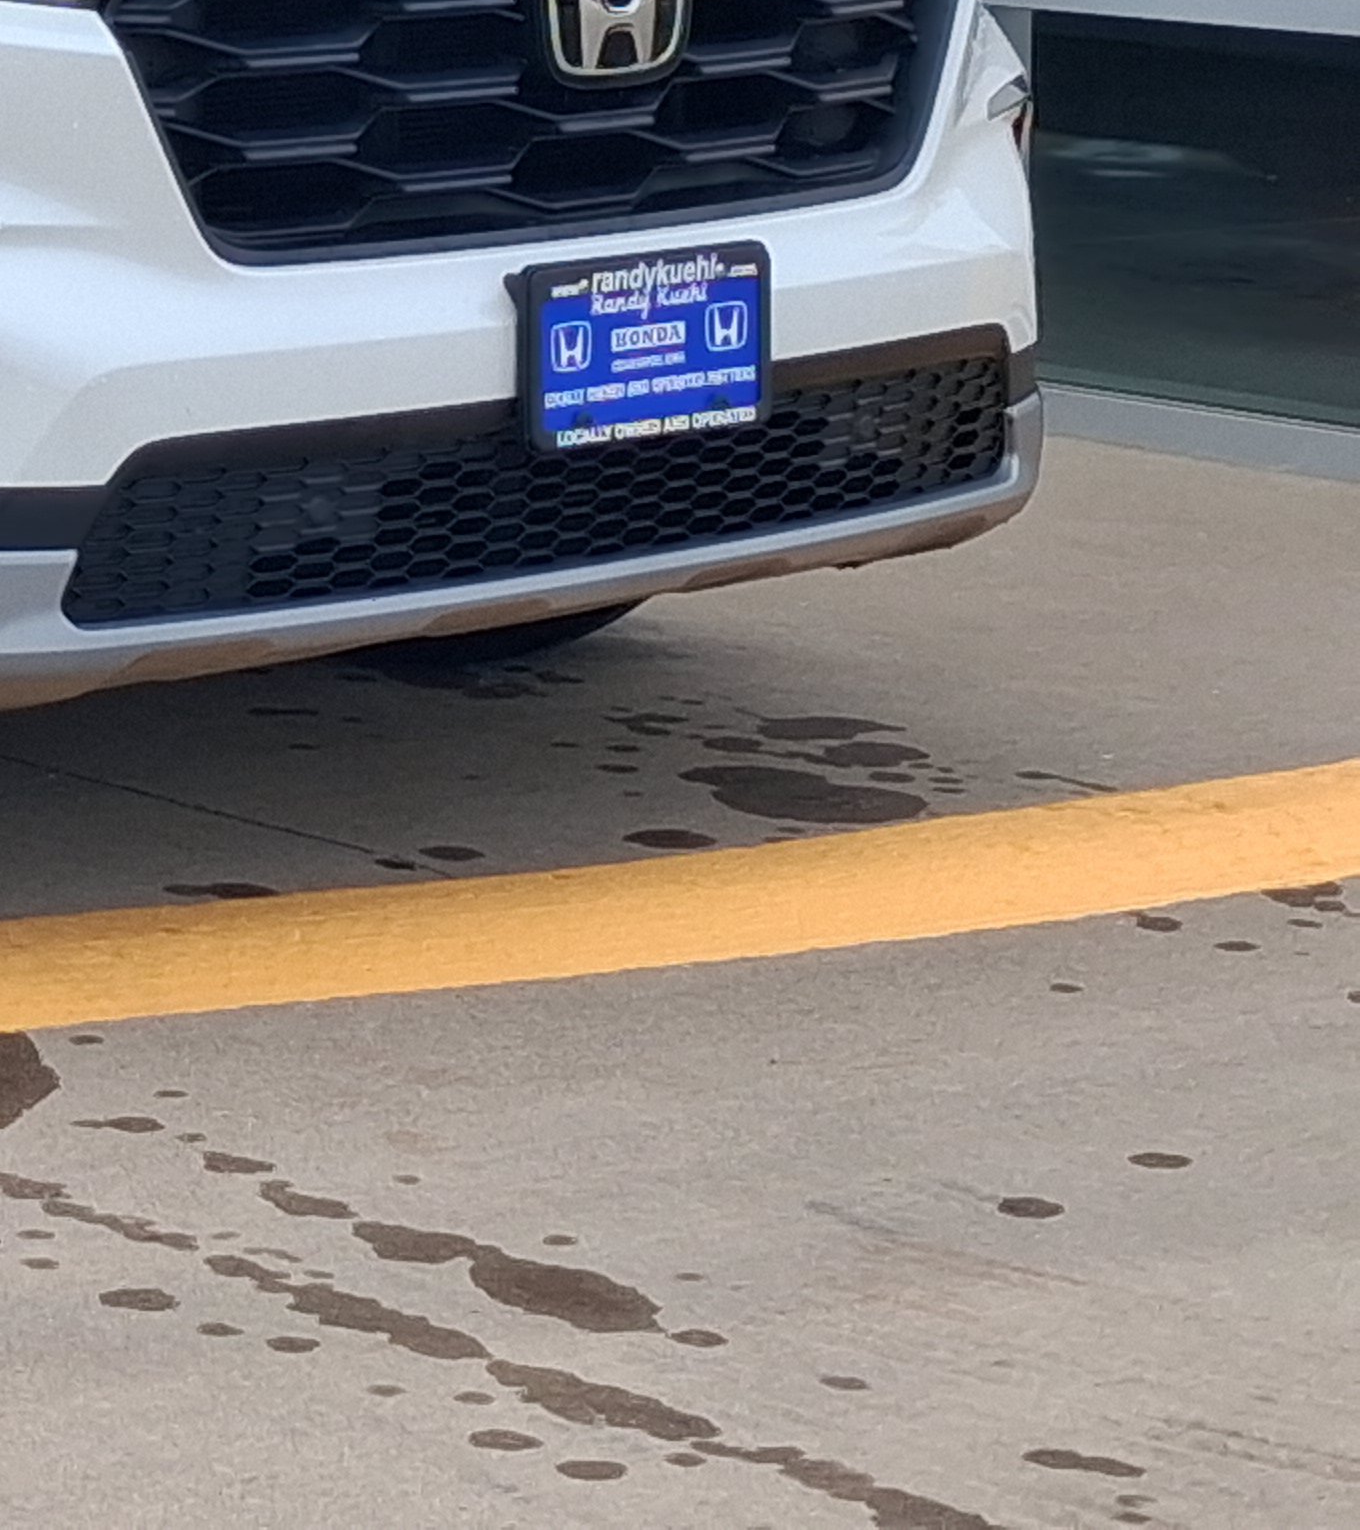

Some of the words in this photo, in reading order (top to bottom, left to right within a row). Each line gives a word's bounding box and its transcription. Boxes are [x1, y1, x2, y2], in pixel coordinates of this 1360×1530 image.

[591, 253, 717, 293] randykuehl
[590, 290, 651, 320] Randy
[614, 328, 682, 347] HONDA
